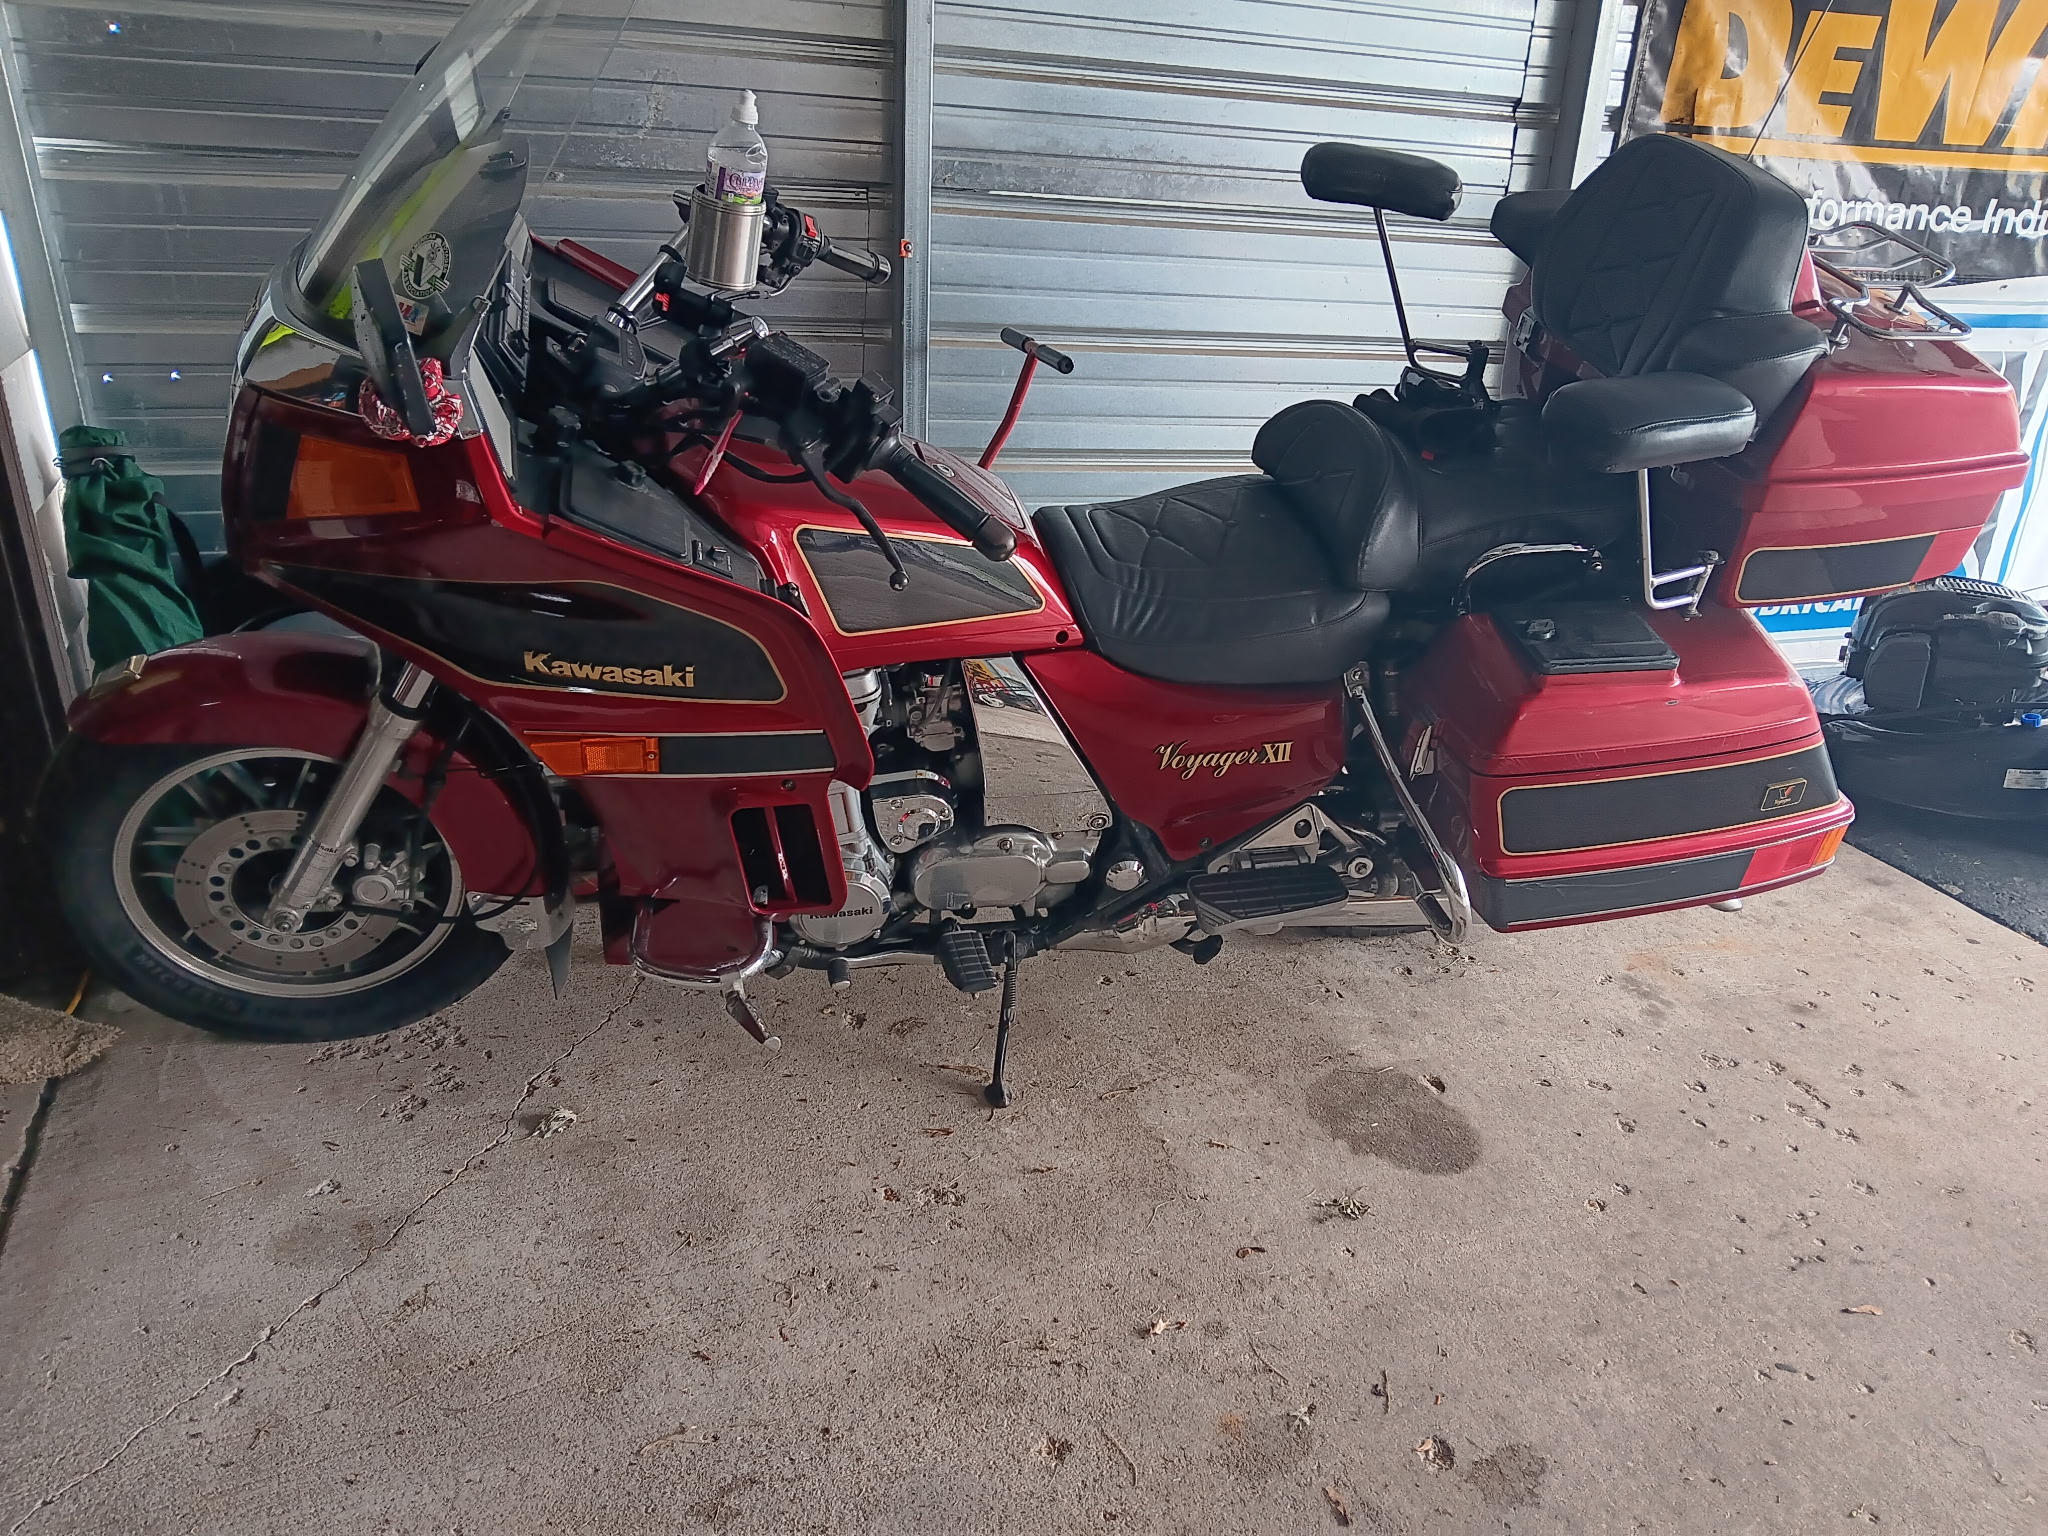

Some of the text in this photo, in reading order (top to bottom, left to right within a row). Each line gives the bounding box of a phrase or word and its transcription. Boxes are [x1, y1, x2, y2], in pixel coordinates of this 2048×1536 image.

[1804, 189, 1972, 233] formance
[523, 650, 695, 688] Kawasaki
[1154, 740, 1294, 780] Voyager XII
